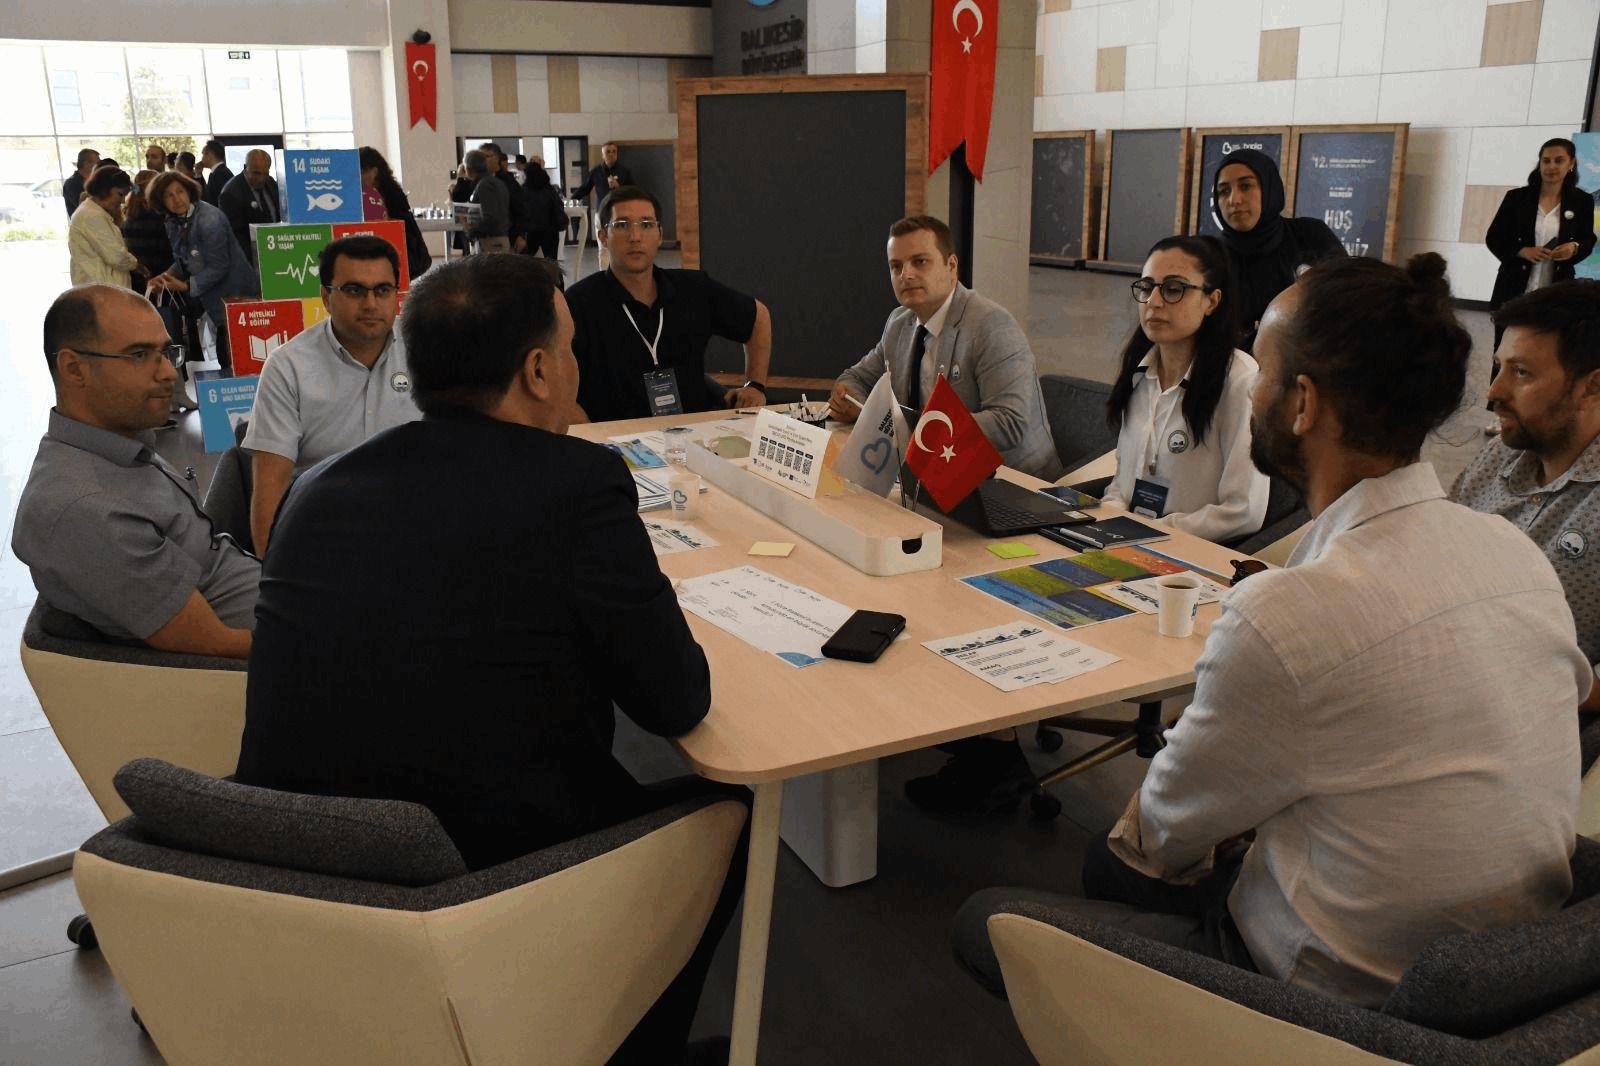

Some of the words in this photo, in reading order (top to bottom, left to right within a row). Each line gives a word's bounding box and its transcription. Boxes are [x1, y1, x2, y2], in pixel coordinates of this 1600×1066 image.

[292, 158, 306, 173] 14
[1325, 209, 1353, 235] HOŞ
[267, 235, 276, 250] 3
[238, 311, 247, 326] 4
[248, 308, 277, 318] NİTELİKLİ
[249, 317, 271, 327] EĞİTİM
[208, 388, 218, 403] 6
